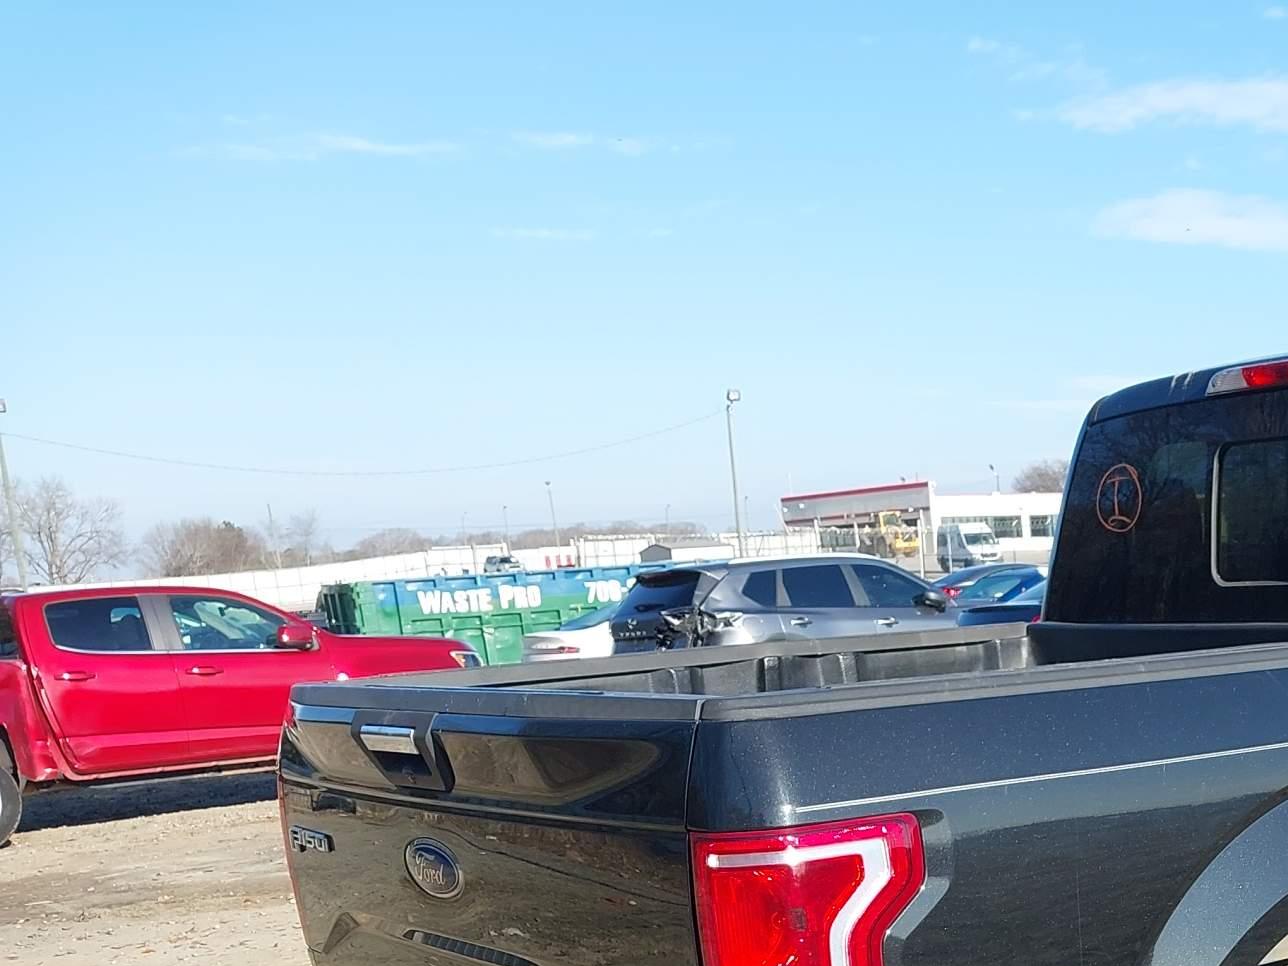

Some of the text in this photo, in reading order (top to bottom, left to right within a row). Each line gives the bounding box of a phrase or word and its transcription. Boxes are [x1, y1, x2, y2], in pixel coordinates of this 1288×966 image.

[417, 588, 494, 615] WASTE
[498, 584, 542, 609] PRO
[415, 851, 446, 885] Ford
